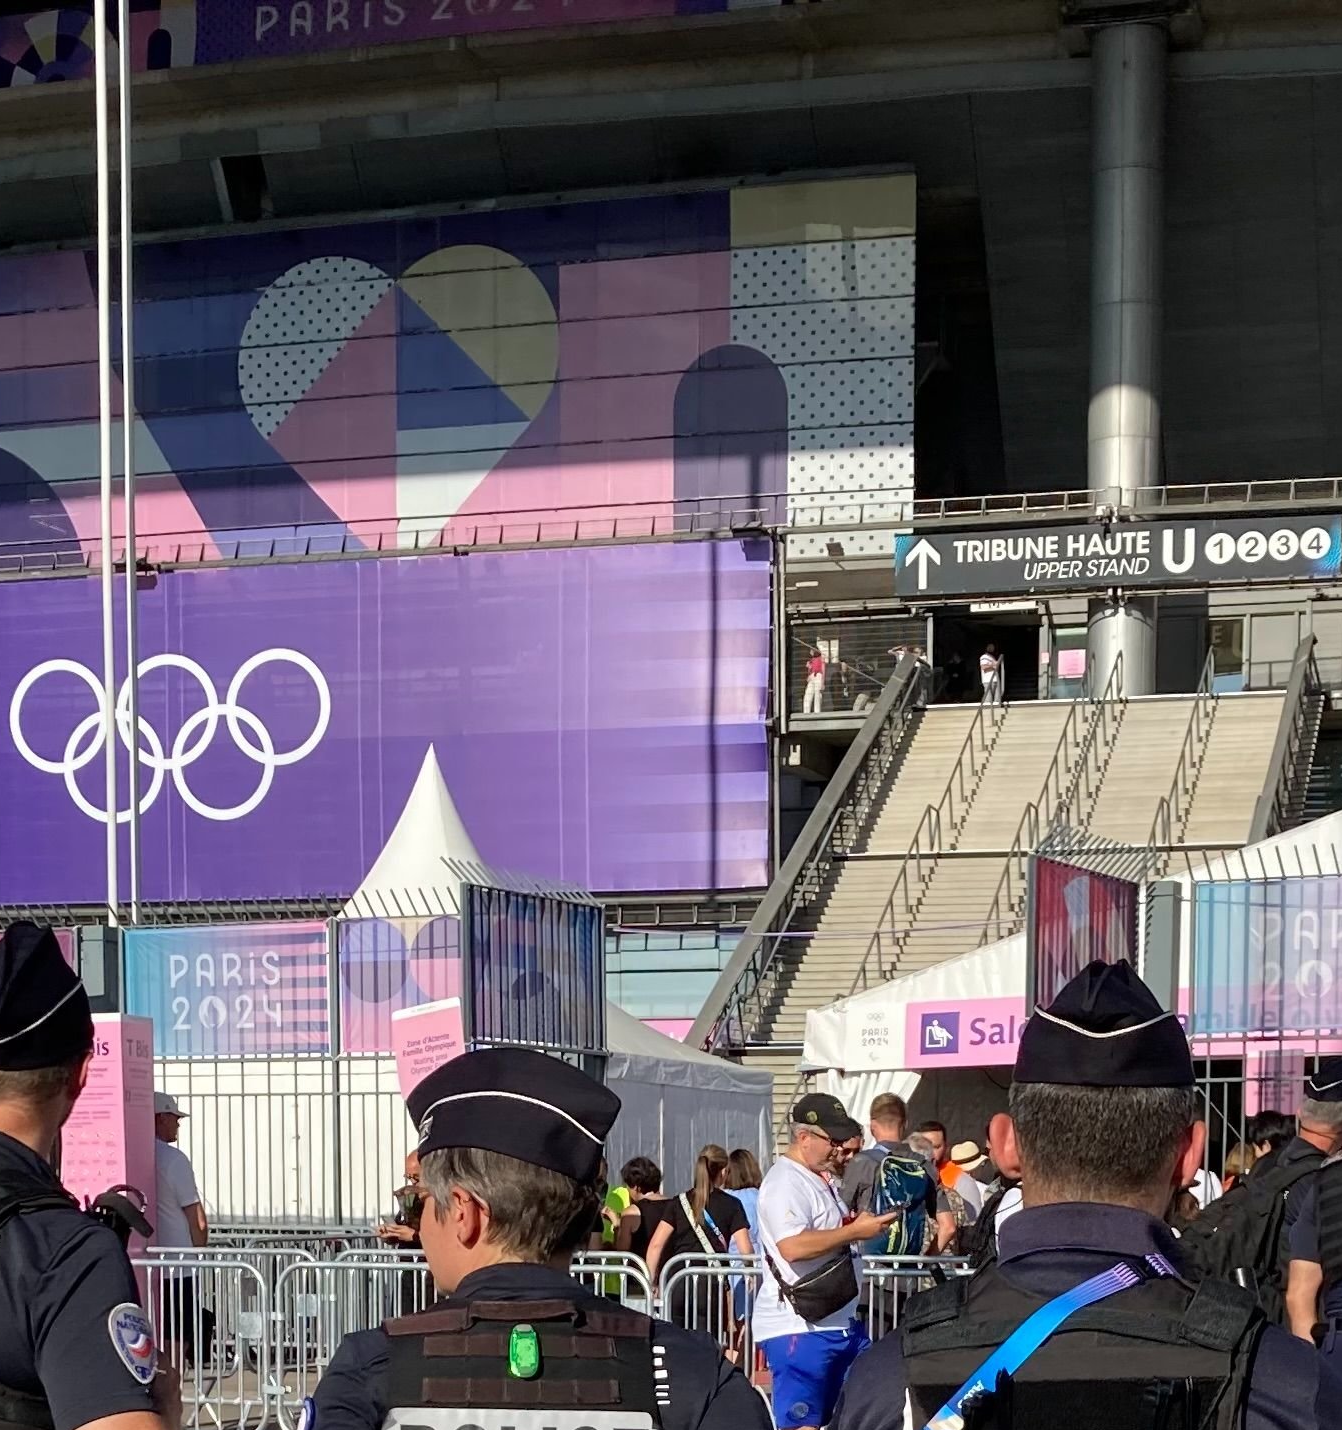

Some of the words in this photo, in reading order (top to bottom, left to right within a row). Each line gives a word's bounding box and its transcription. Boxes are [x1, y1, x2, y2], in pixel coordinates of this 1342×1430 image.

[953, 535, 1059, 564] TRIBUNE
[1067, 531, 1150, 558] HAUTE
[1162, 527, 1197, 574] U
[1023, 560, 1085, 582] UPPER
[1085, 557, 1150, 578] STAND
[171, 993, 282, 1031] 2024
[861, 1037, 889, 1047] 2024
[969, 1015, 1025, 1046] Sal
[126, 1038, 133, 1057] T
[136, 1039, 149, 1059] Bis
